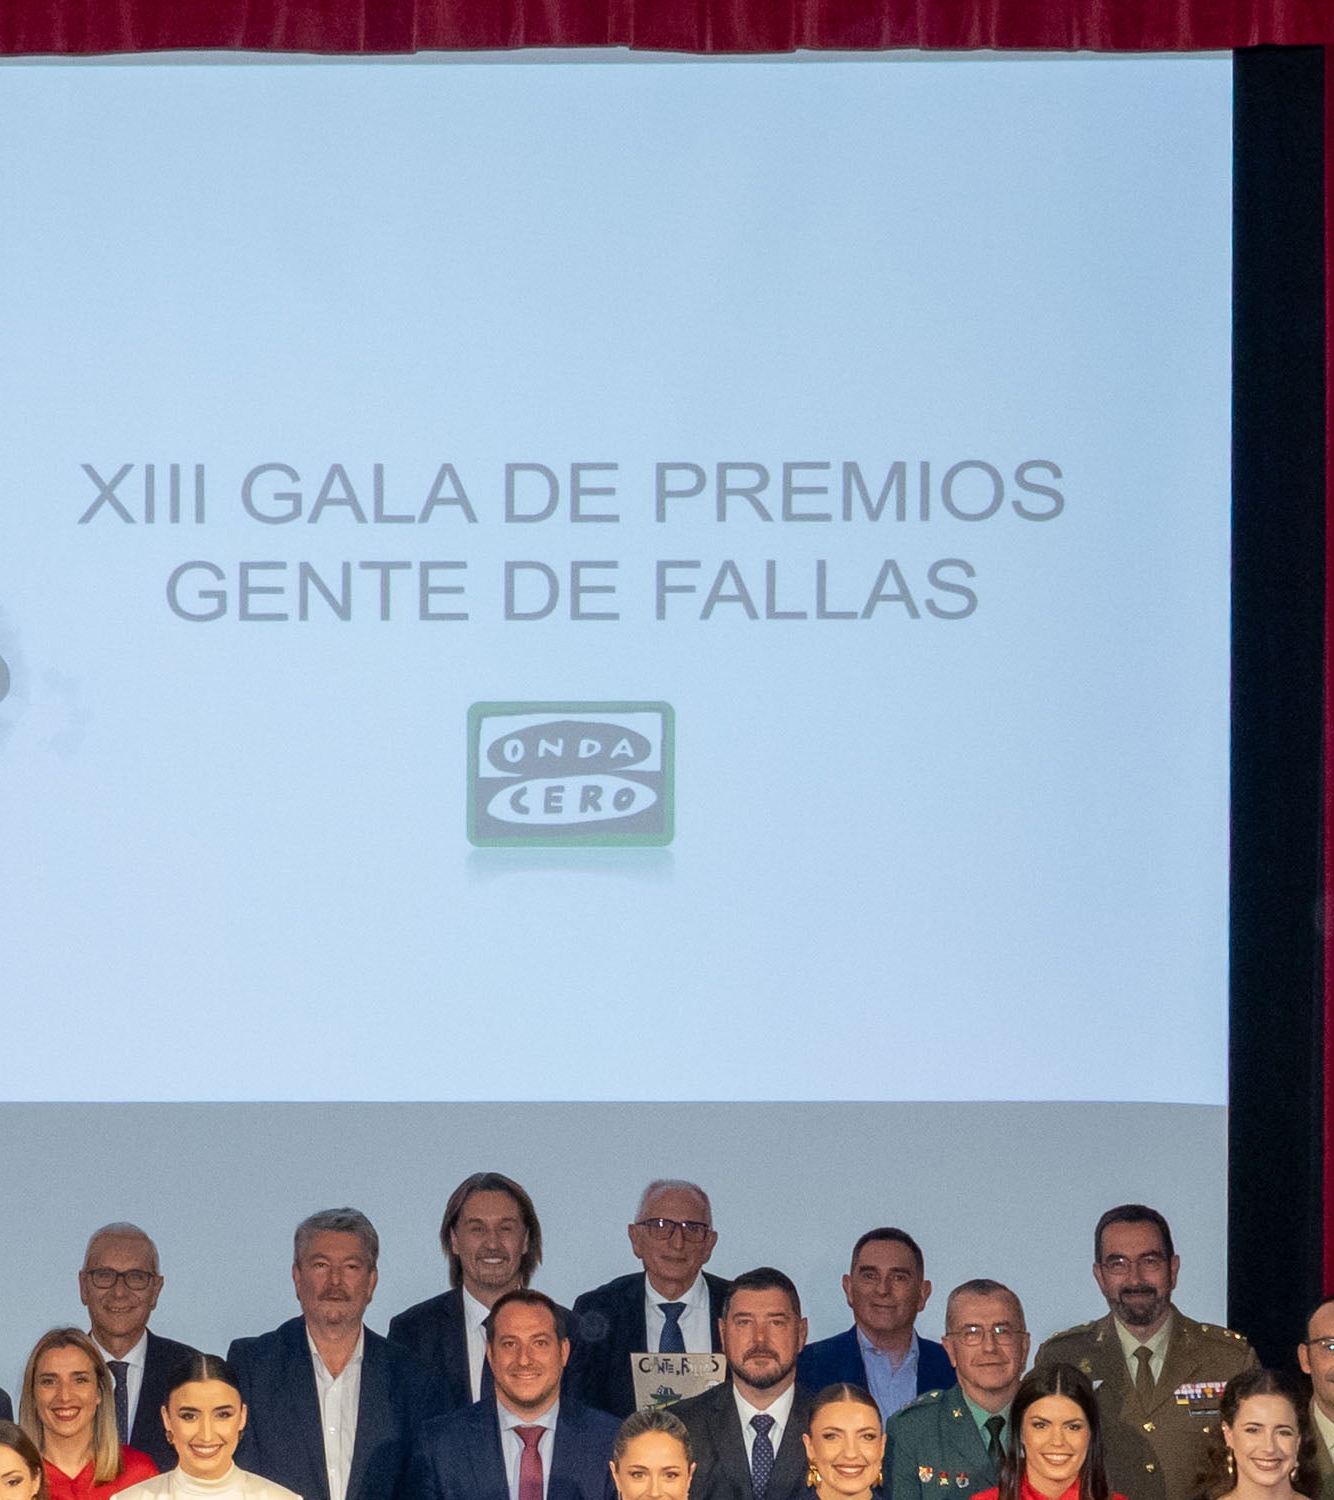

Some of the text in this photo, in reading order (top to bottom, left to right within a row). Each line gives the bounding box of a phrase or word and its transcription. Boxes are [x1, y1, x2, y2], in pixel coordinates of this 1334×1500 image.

[78, 458, 1066, 525] XIII GALA DE PREMIOS
[166, 557, 979, 623] GENTE DE FALLAS
[503, 737, 635, 763] ONDA
[509, 784, 636, 815] CERO
